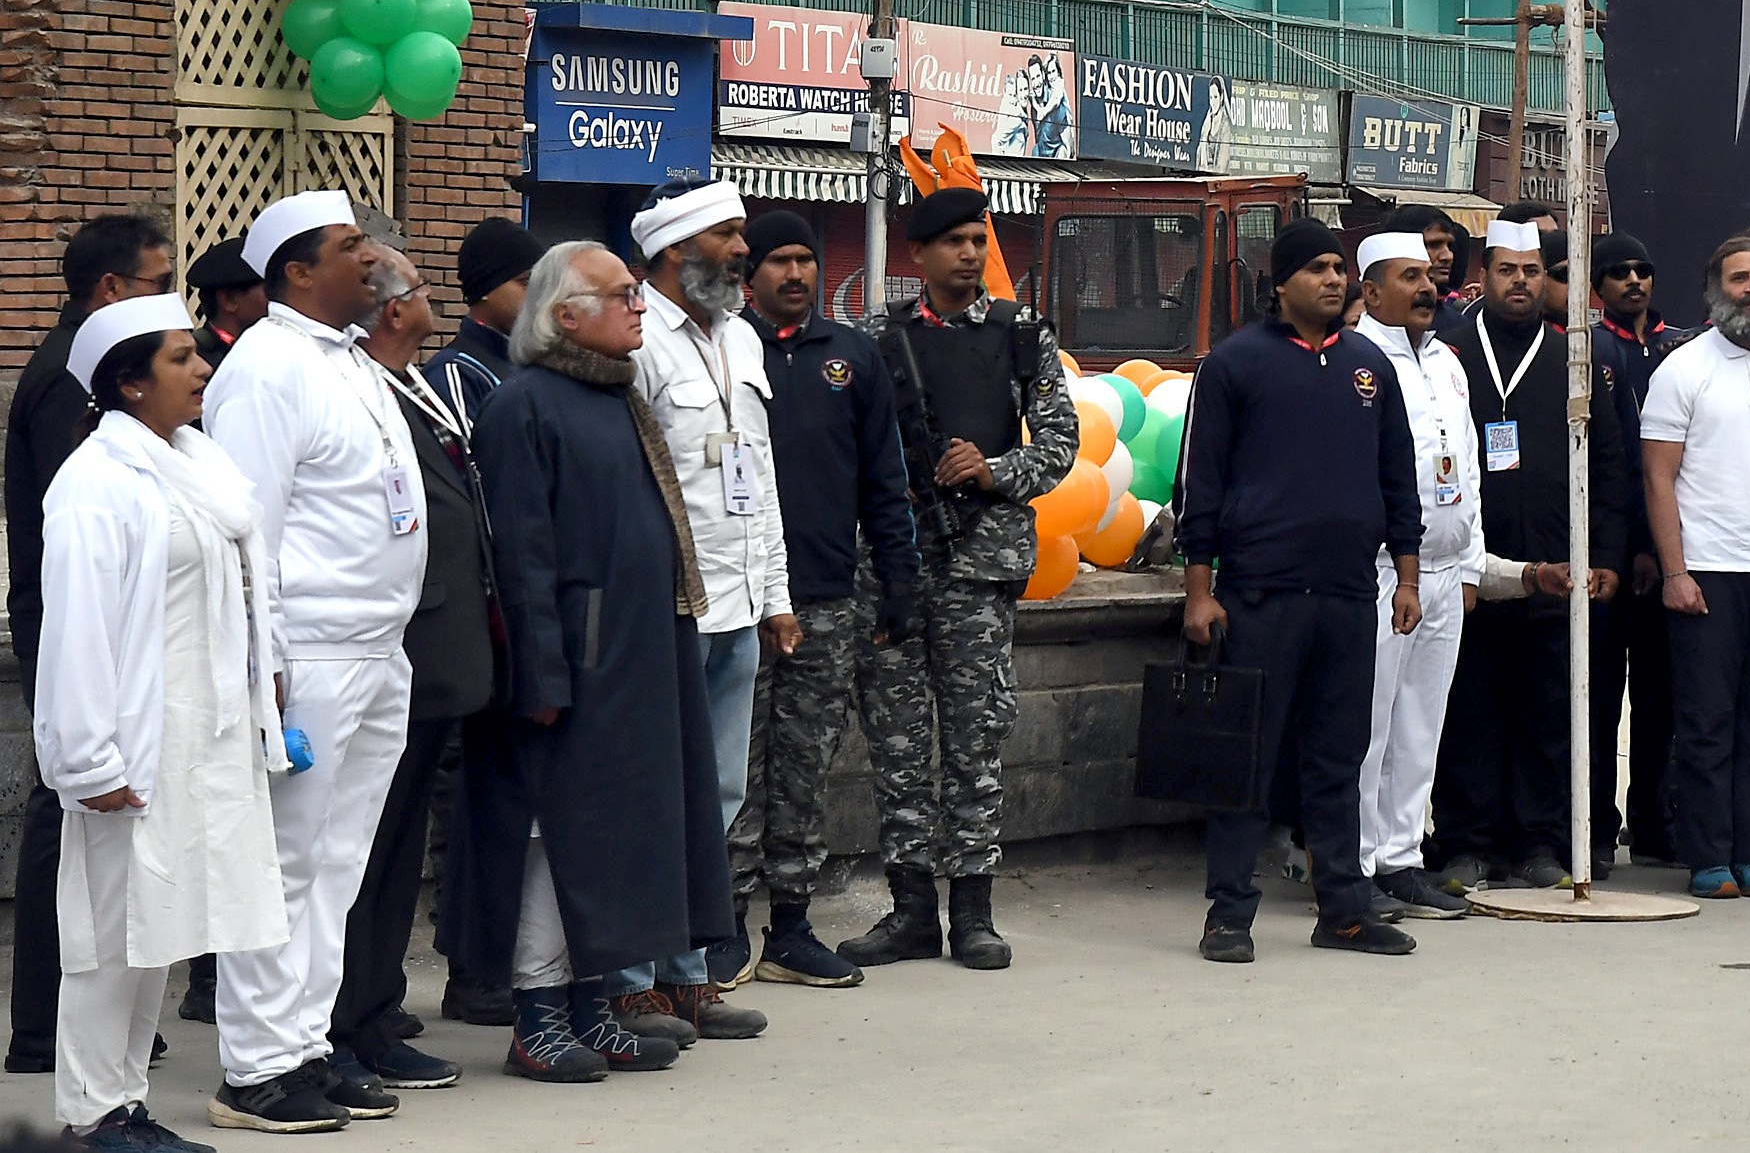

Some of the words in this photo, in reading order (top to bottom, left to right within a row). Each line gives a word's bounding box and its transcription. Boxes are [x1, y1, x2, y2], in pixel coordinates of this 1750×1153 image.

[767, 20, 901, 77] TITA
[552, 53, 679, 96] SAMSUNG
[913, 54, 1005, 97] Rashid
[1083, 58, 1194, 112] FASHION
[728, 83, 796, 109] ROBERTA
[800, 88, 852, 112] WATCH
[854, 91, 902, 115] HOE
[1230, 97, 1245, 126] OHD
[1251, 99, 1292, 132] MAQBOOL
[569, 110, 663, 162] Galaxy
[1105, 102, 1143, 135] Wear
[1145, 108, 1191, 142] House
[1363, 117, 1441, 155] BUTT
[1399, 156, 1438, 175] Fabrics
[1523, 129, 1567, 170] BUT
[1520, 176, 1554, 201] LOTH
